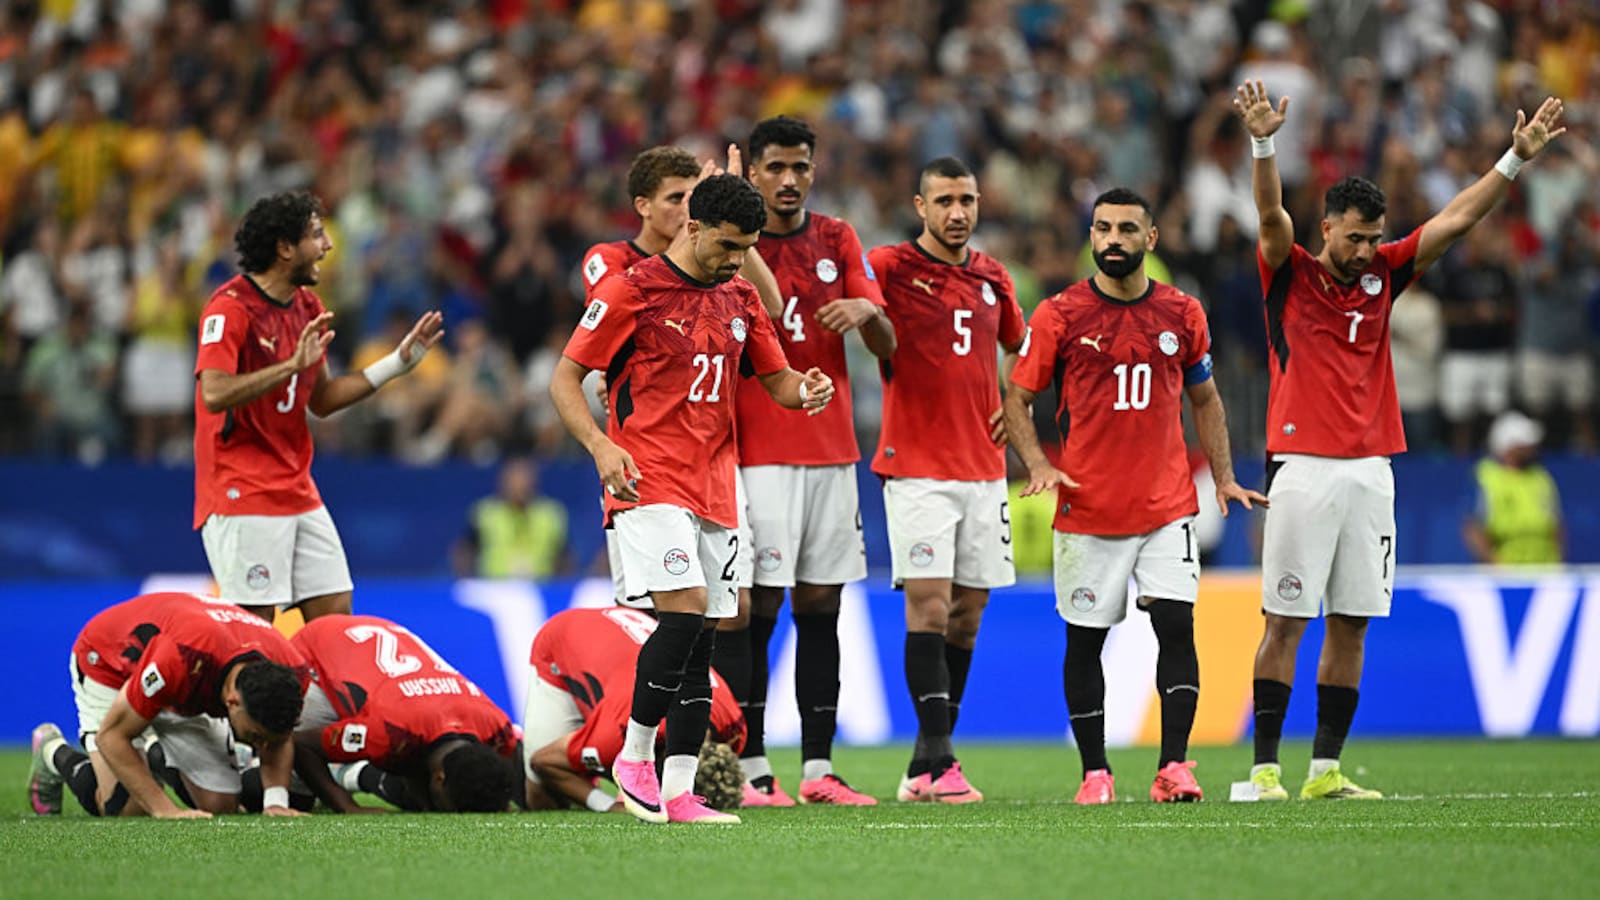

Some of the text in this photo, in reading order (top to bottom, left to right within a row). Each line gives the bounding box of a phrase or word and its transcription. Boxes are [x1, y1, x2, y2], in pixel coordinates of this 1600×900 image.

[783, 295, 806, 342] 4
[952, 309, 973, 356] 5
[1345, 310, 1364, 343] 7
[276, 372, 298, 413] 3
[688, 353, 726, 403] 21
[1113, 363, 1152, 411] 10
[720, 535, 740, 582] 2
[1381, 535, 1391, 579] 7
[398, 677, 462, 697] HASSAN
